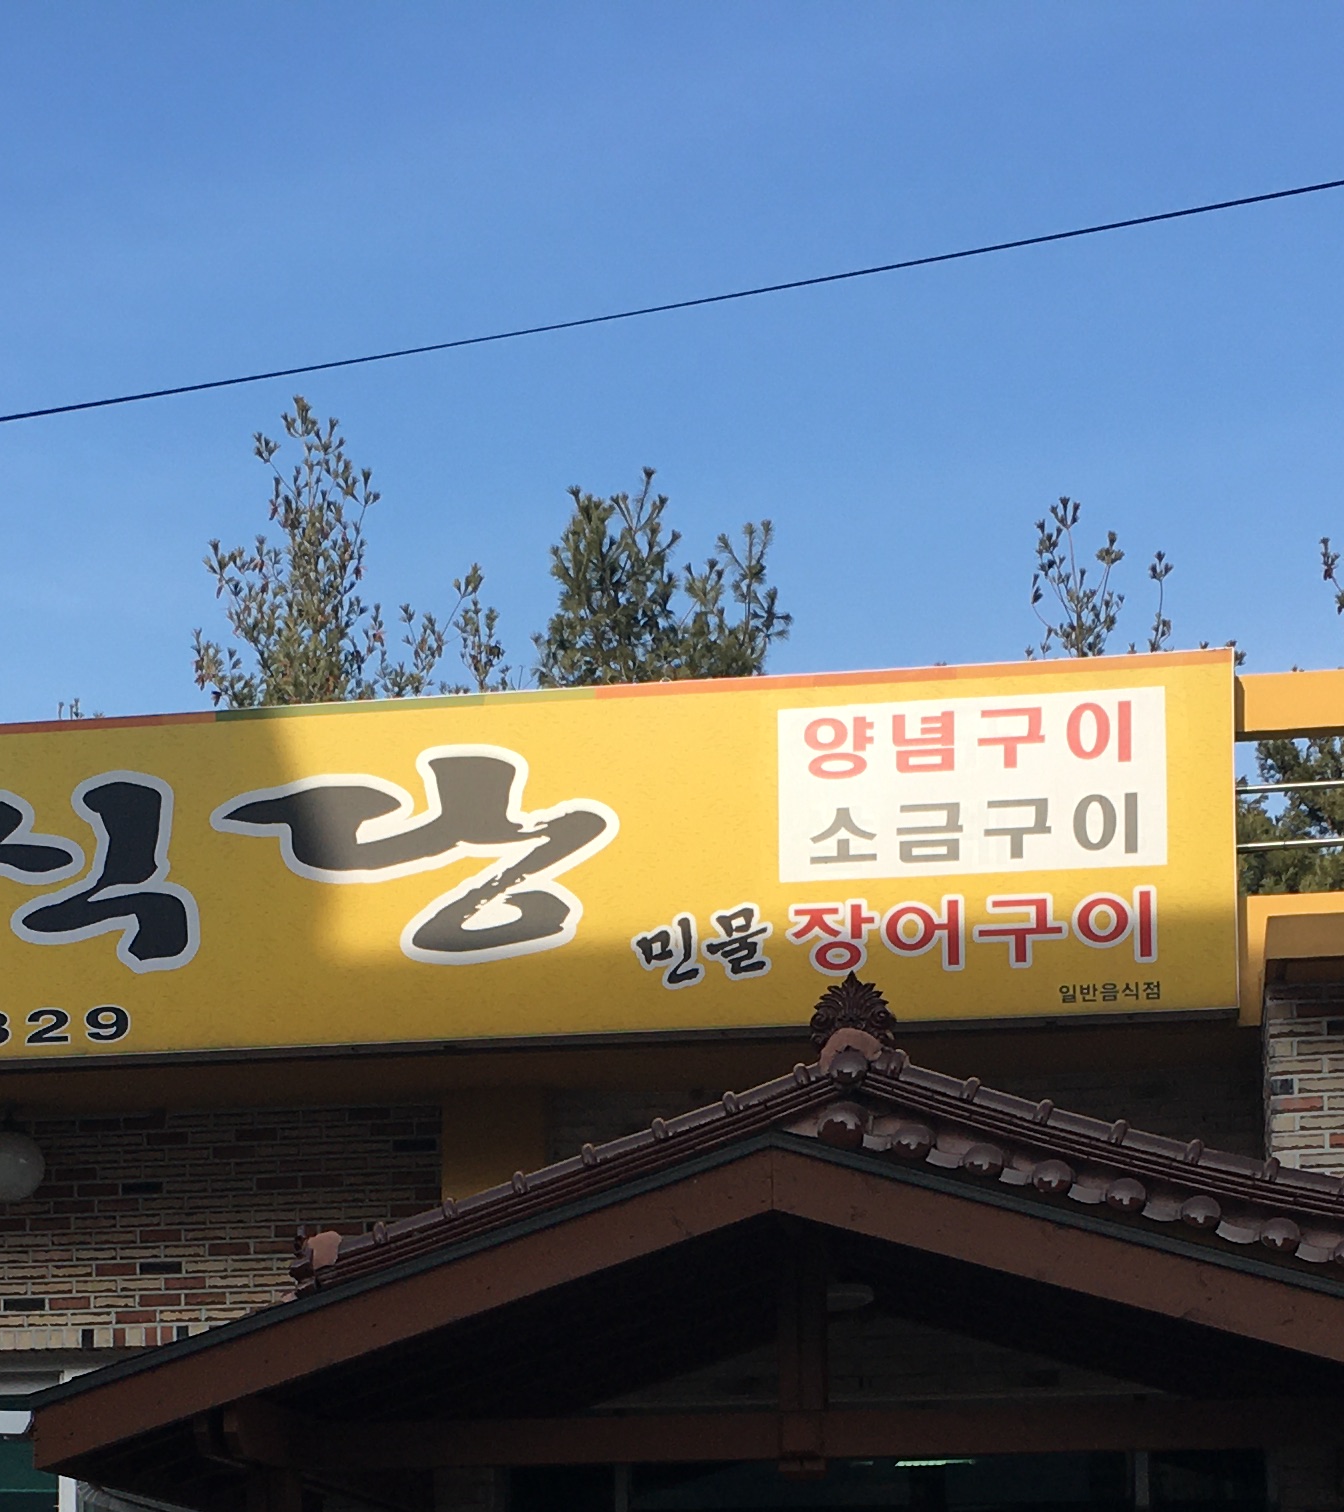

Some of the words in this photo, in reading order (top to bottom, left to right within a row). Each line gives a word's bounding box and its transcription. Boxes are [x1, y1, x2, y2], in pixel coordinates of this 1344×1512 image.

[803, 700, 1134, 779] 양념구이
[808, 793, 1141, 866] 소금구이
[633, 904, 771, 988] 민물
[787, 886, 1158, 975] 장어구이
[1059, 981, 1160, 1003] 일반음식점
